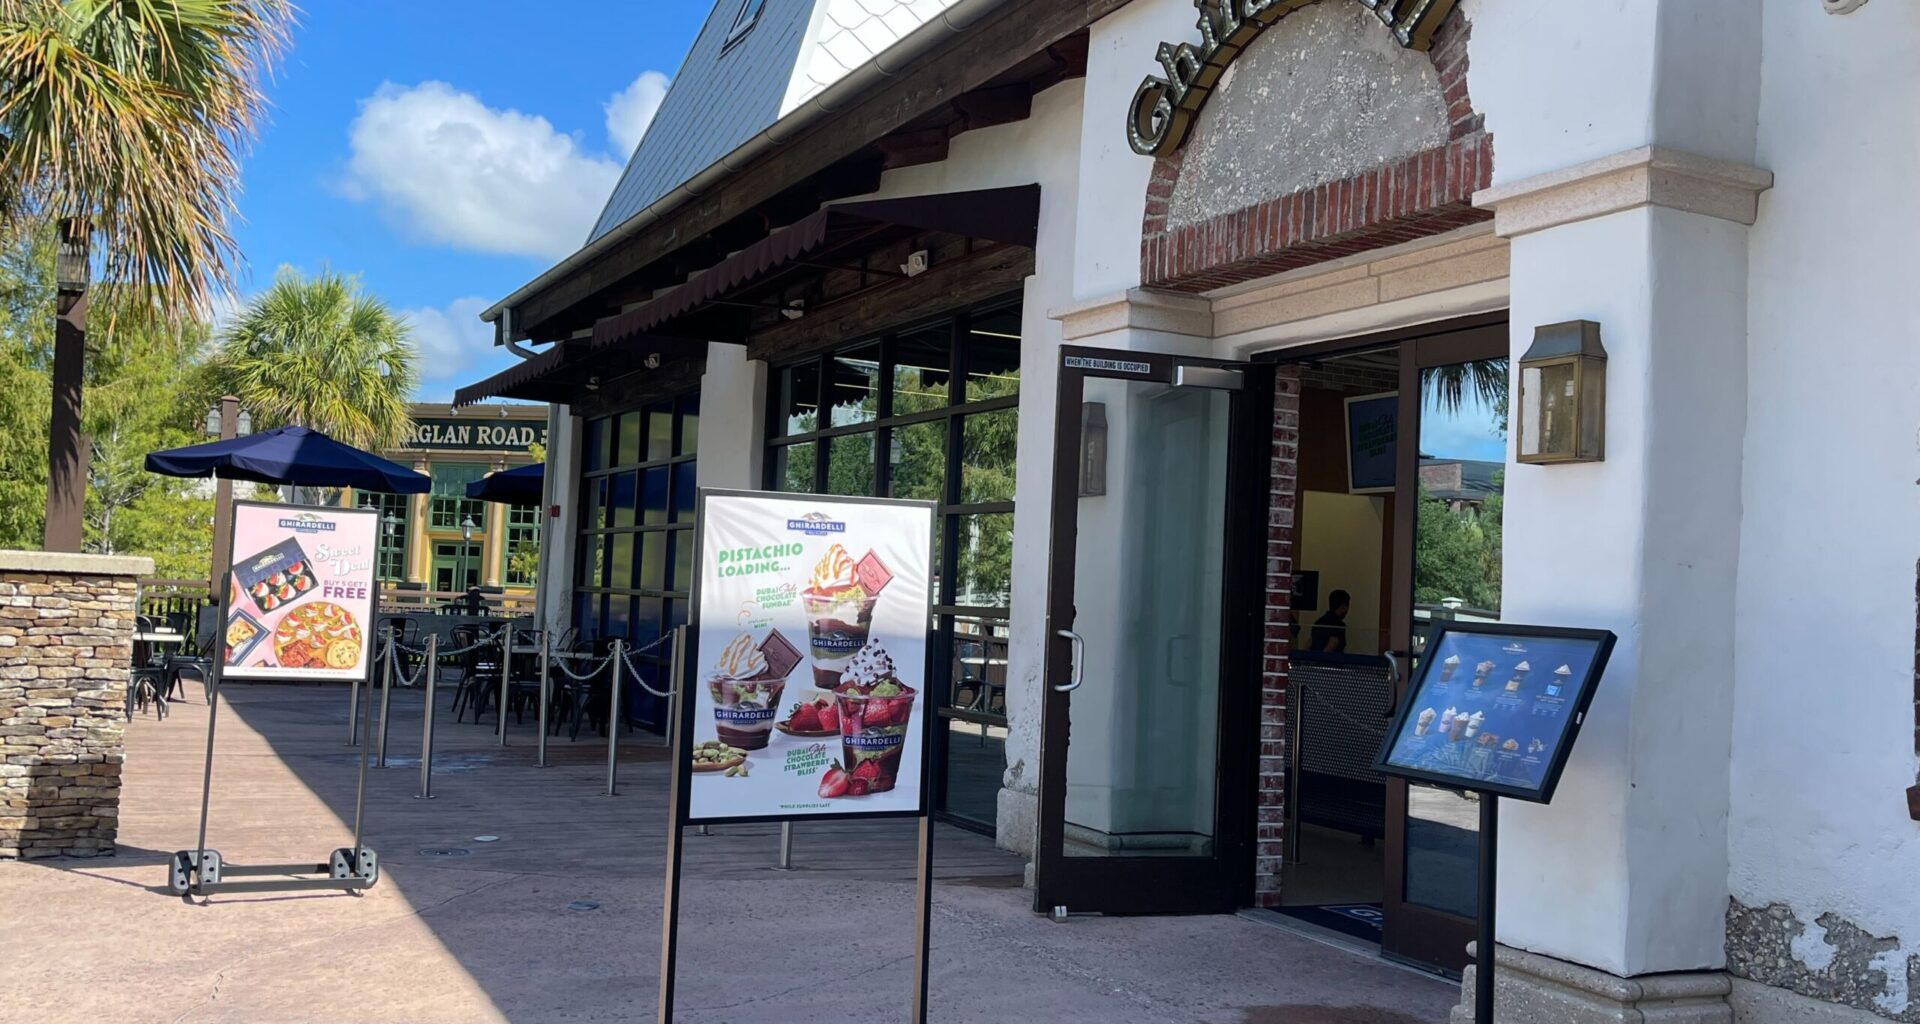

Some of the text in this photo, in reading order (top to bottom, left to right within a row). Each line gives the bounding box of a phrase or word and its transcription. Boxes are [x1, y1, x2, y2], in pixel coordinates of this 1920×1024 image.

[1066, 357, 1149, 372] WHEN THE BUILDING IS OCCUPIED
[403, 424, 535, 446] AGLAN ROAD
[280, 520, 334, 530] GHIRARDELLI
[789, 521, 843, 531] GHIRARDELLI
[719, 542, 804, 563] PISTACHIO
[718, 561, 790, 578] LOADING...
[323, 586, 367, 599] FREE
[756, 587, 778, 595] DUBAI
[756, 592, 797, 602] CHOCOLATE
[813, 639, 866, 647] GHIRARDELLI
[716, 711, 773, 719] GHIRARDELLI
[845, 736, 900, 745] GHIRARDELLI
[787, 748, 808, 757] DUBAI
[787, 752, 826, 764] CHOCOLATE
[784, 758, 829, 772] STRAWBERRY
